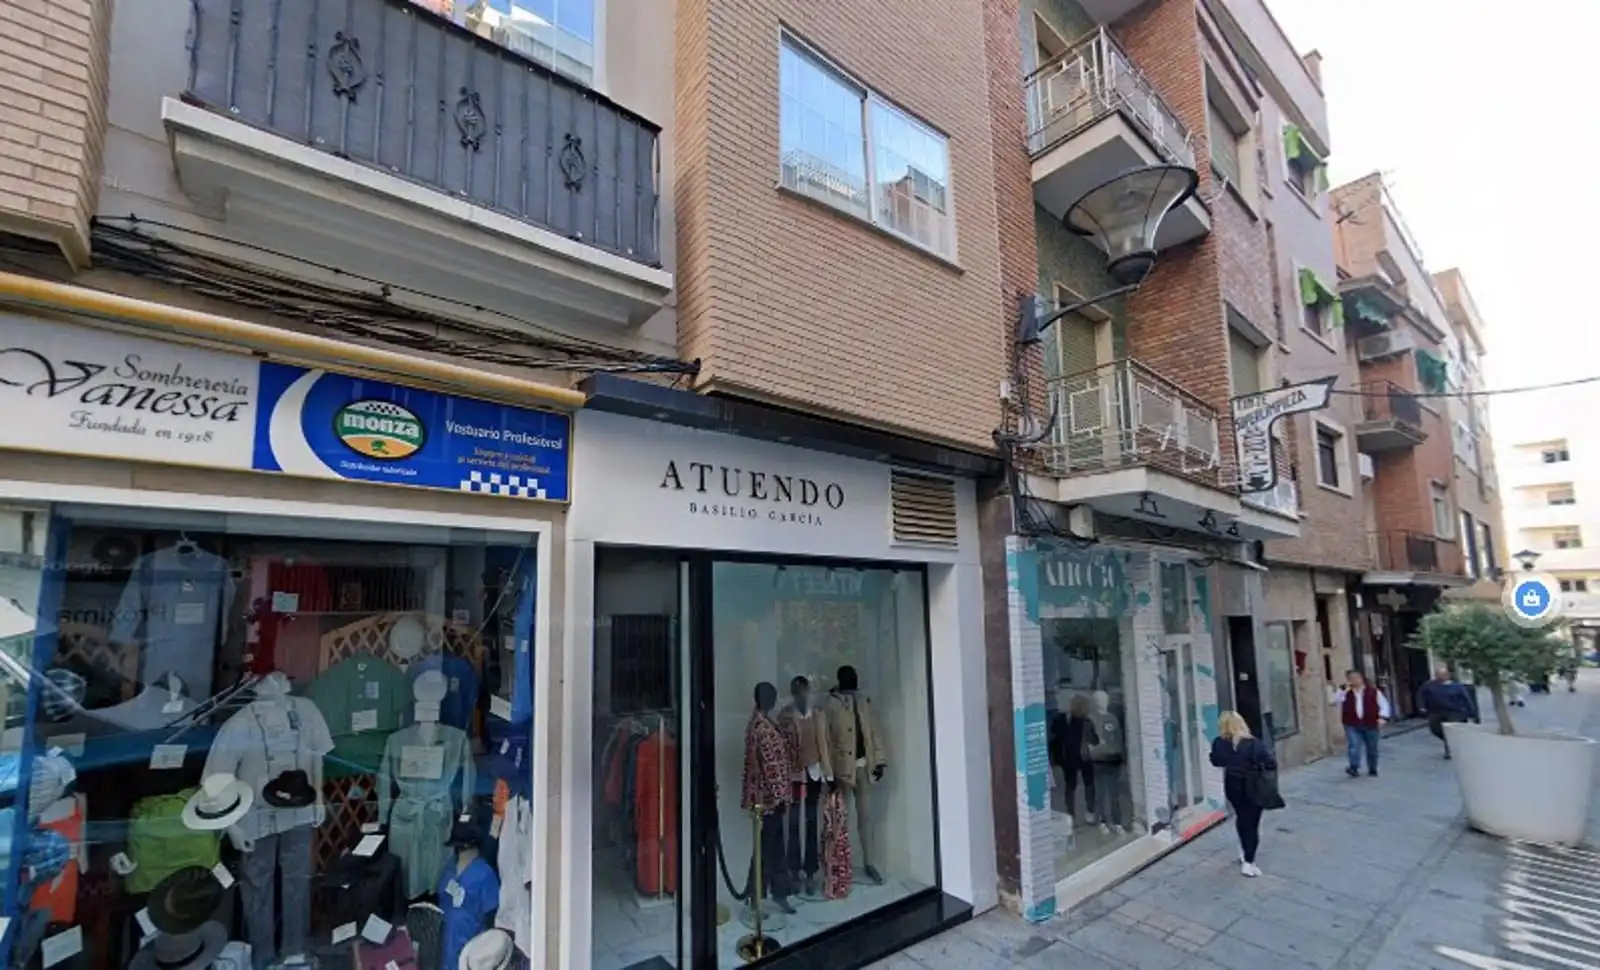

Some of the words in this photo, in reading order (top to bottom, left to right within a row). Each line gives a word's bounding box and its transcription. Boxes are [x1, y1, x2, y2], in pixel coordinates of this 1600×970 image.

[0, 348, 249, 422] Vanessa
[113, 353, 249, 396] Sombrerería
[68, 410, 147, 436] Fundada
[155, 429, 172, 439] en
[177, 430, 214, 444] 1918
[343, 412, 420, 439] monza
[445, 419, 500, 440] Vestuario
[503, 430, 563, 450] Profesional
[660, 459, 845, 510] ATUENDO
[689, 502, 758, 519] BASILIO
